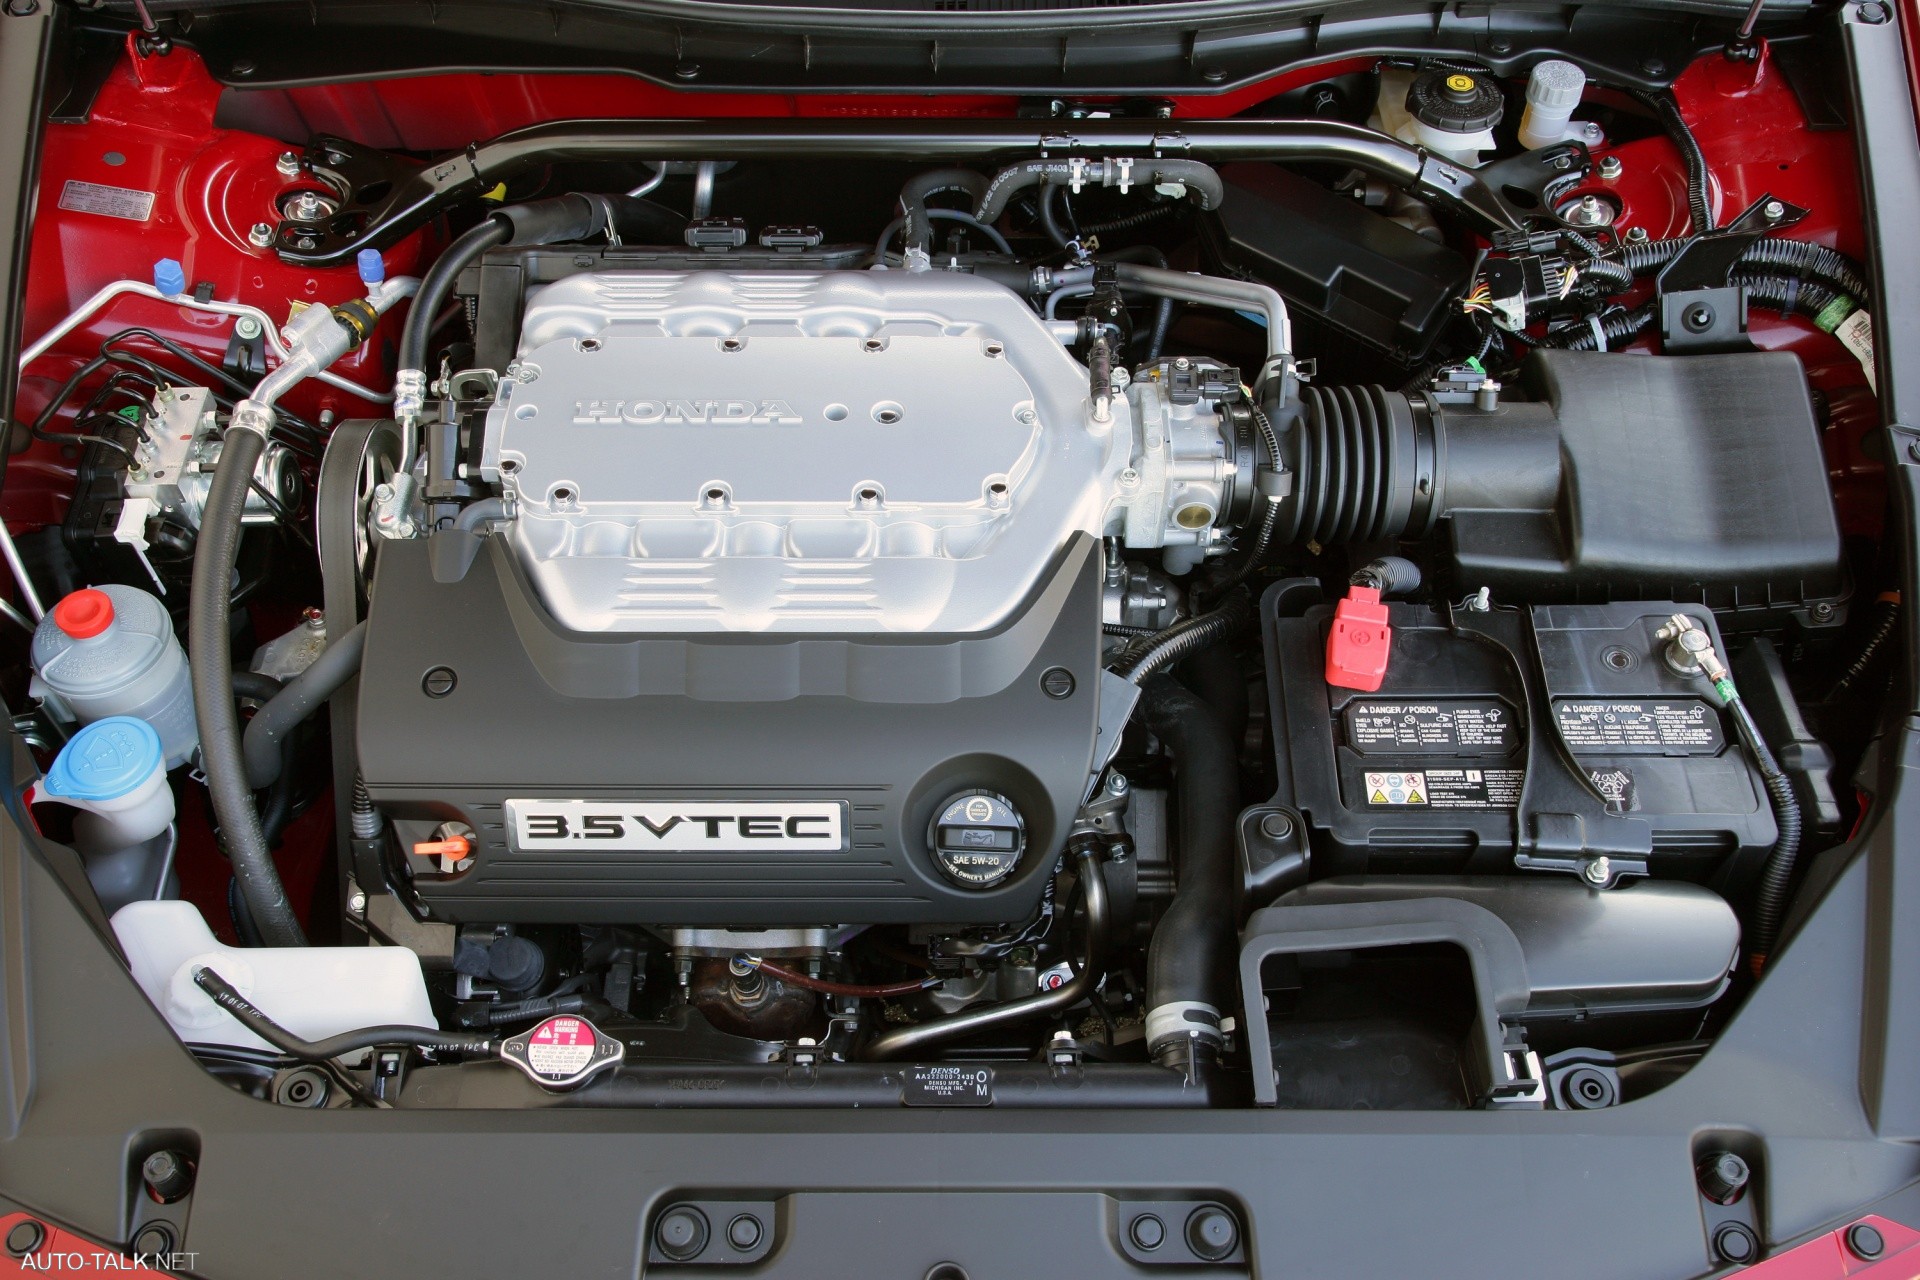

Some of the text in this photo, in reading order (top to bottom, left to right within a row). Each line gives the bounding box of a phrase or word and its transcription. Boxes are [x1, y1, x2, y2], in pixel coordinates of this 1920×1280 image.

[573, 400, 803, 423] HONDA
[945, 803, 965, 821] ENGINE
[996, 807, 1007, 818] OIL
[526, 815, 831, 840] 3.5 VTEC
[953, 855, 999, 866] SAE 5W-20
[948, 864, 1006, 881] SEE OWNER'S MANUAL
[930, 1067, 960, 1075] DENSO
[976, 1084, 988, 1096] M
